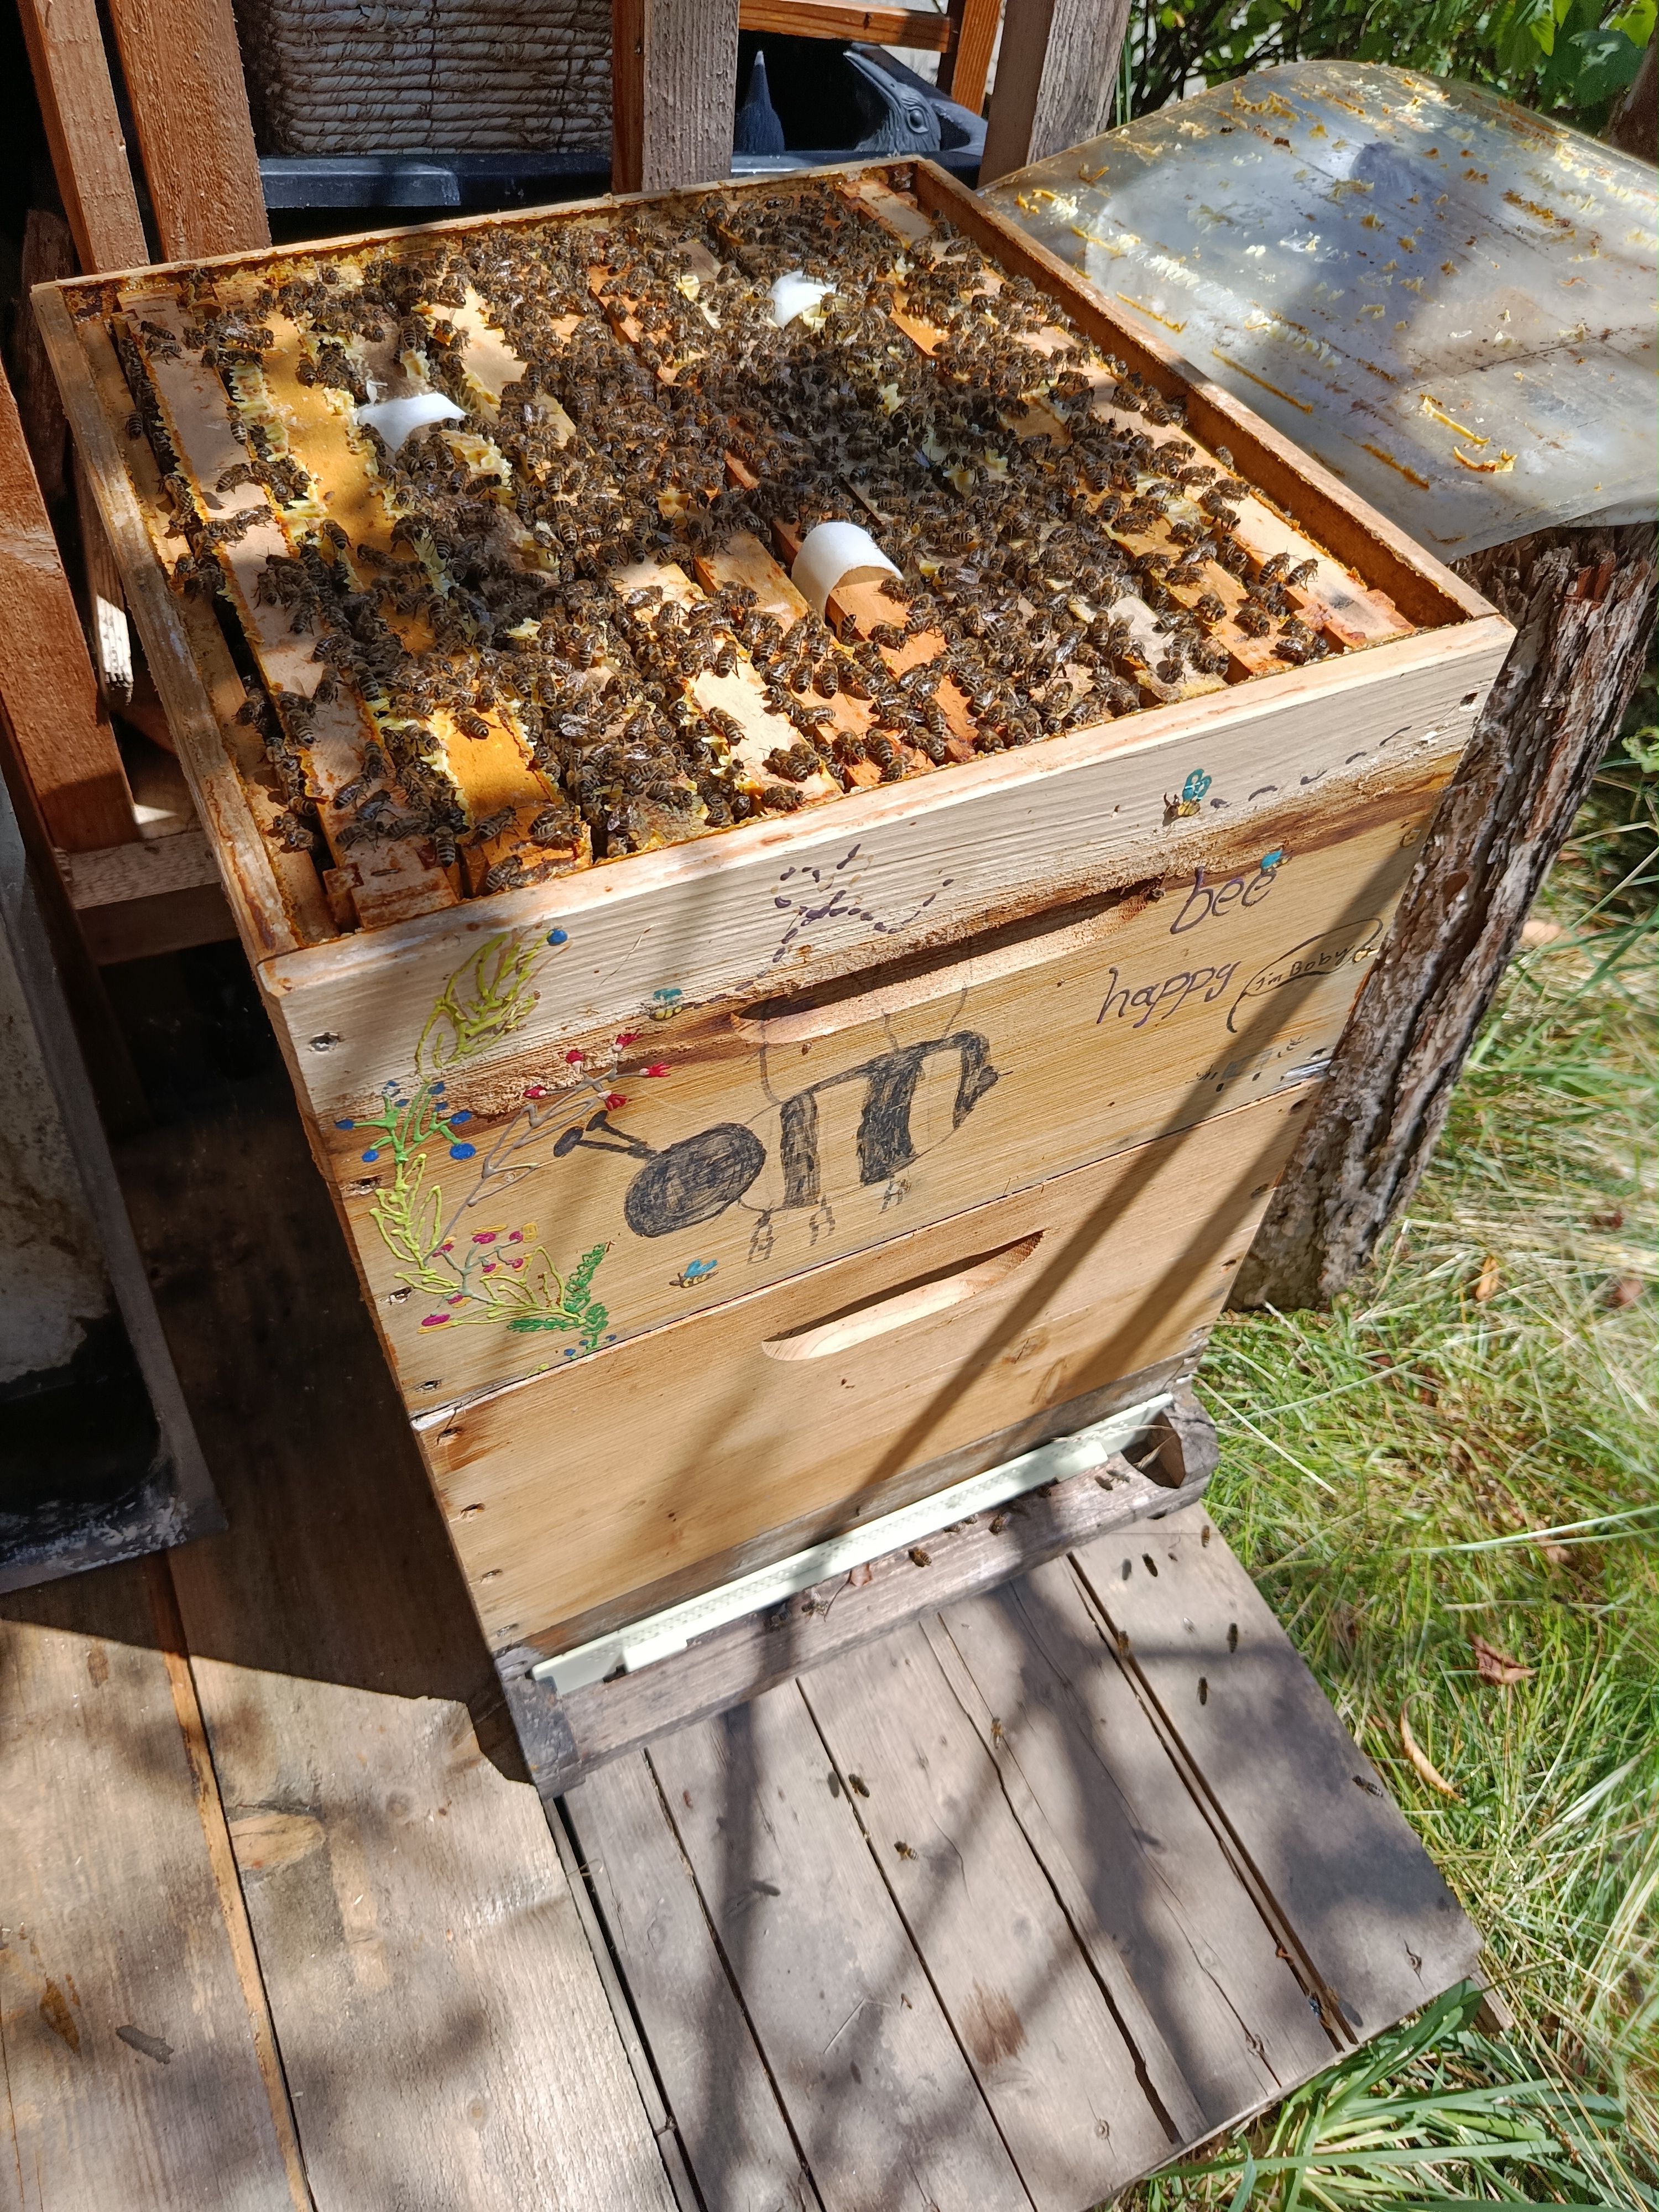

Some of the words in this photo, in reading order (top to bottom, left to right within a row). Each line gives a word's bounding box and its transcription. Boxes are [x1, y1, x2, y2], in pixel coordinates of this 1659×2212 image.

[1170, 866, 1277, 935] bee
[1096, 961, 1242, 1028] happy
[1289, 945, 1355, 977] Boby
